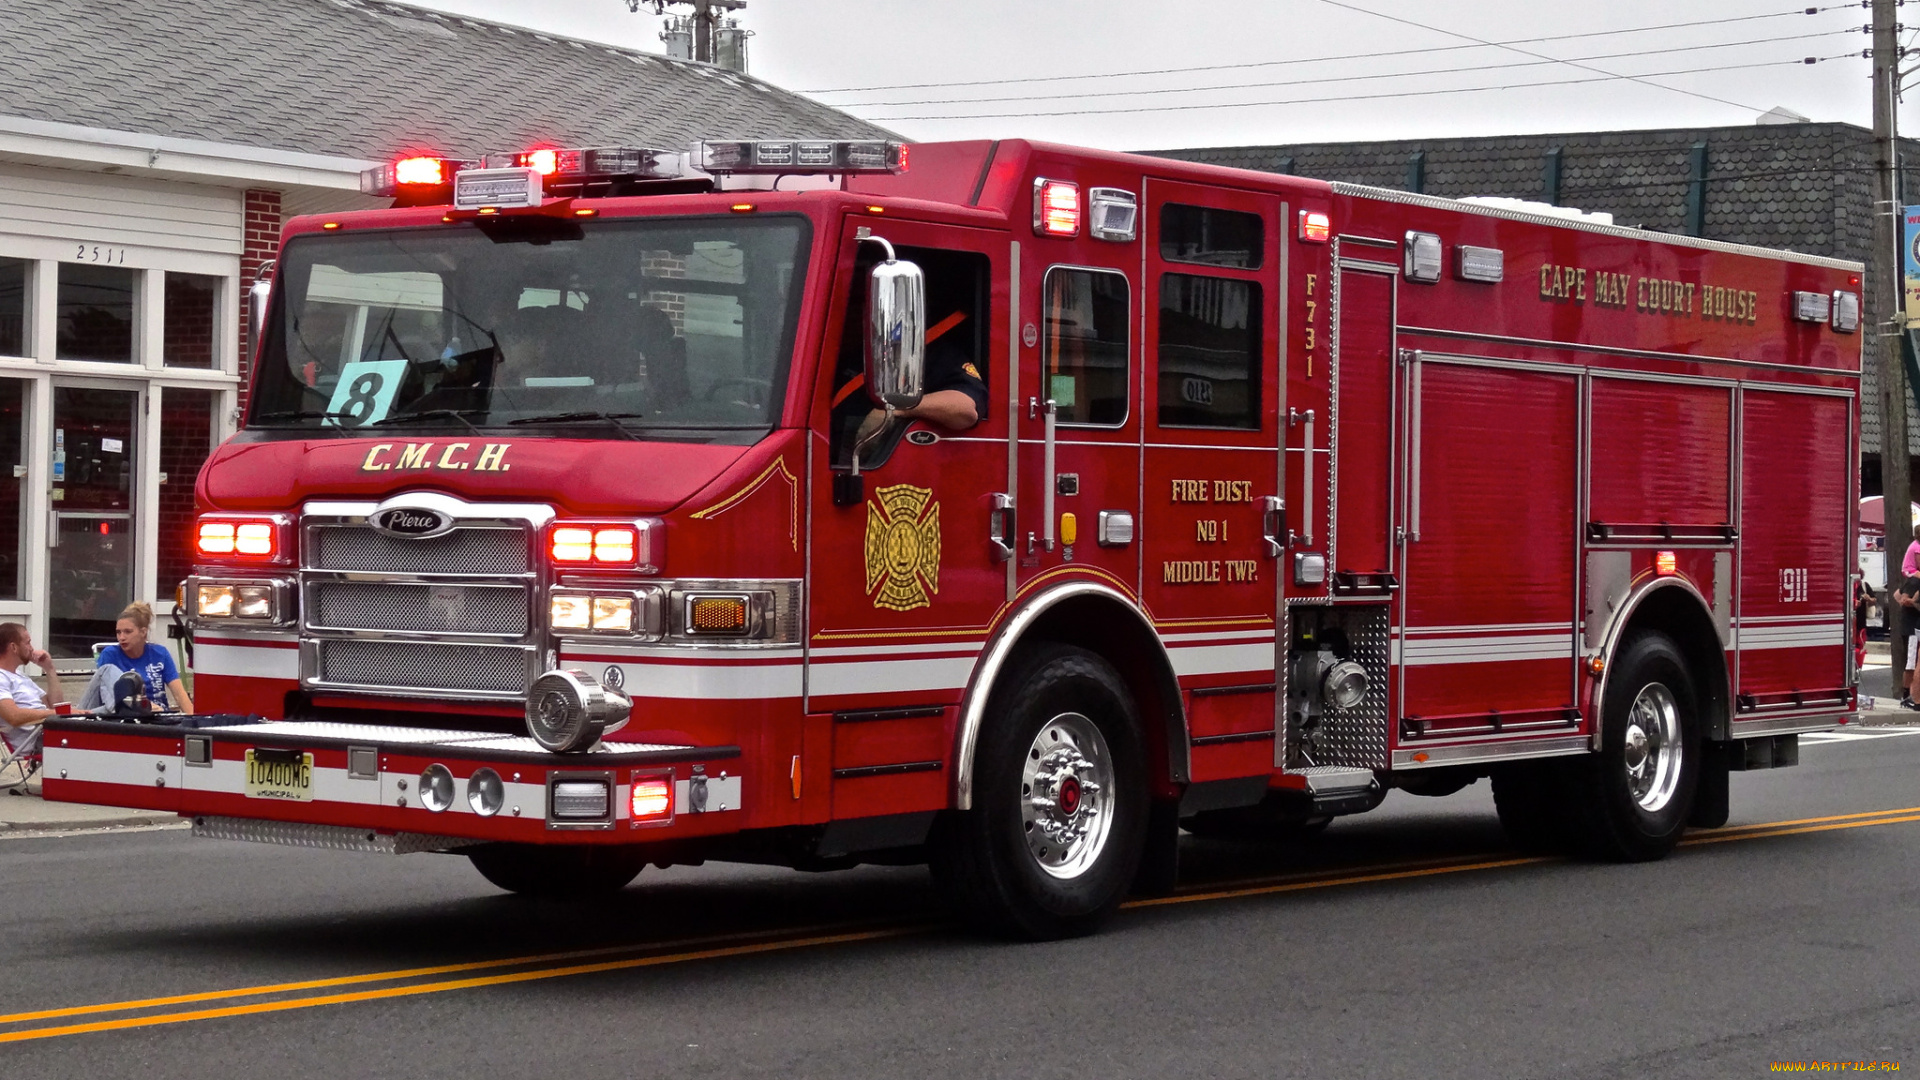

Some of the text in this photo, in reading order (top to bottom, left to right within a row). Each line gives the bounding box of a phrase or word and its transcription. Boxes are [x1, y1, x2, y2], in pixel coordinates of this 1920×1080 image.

[77, 244, 124, 264] 2511
[1540, 263, 1757, 321] CAPE MAY COURT HOUSE
[1306, 273, 1317, 377] F731
[338, 372, 384, 427] 8
[362, 443, 511, 471] C.M.C.H.
[1172, 479, 1253, 502] FIRE DIST.
[389, 510, 434, 530] Pierce
[1222, 519, 1228, 541] 1
[1163, 560, 1258, 582] MIDDLE TWP.
[1783, 568, 1808, 602] 911
[249, 761, 310, 788] 10400MG
